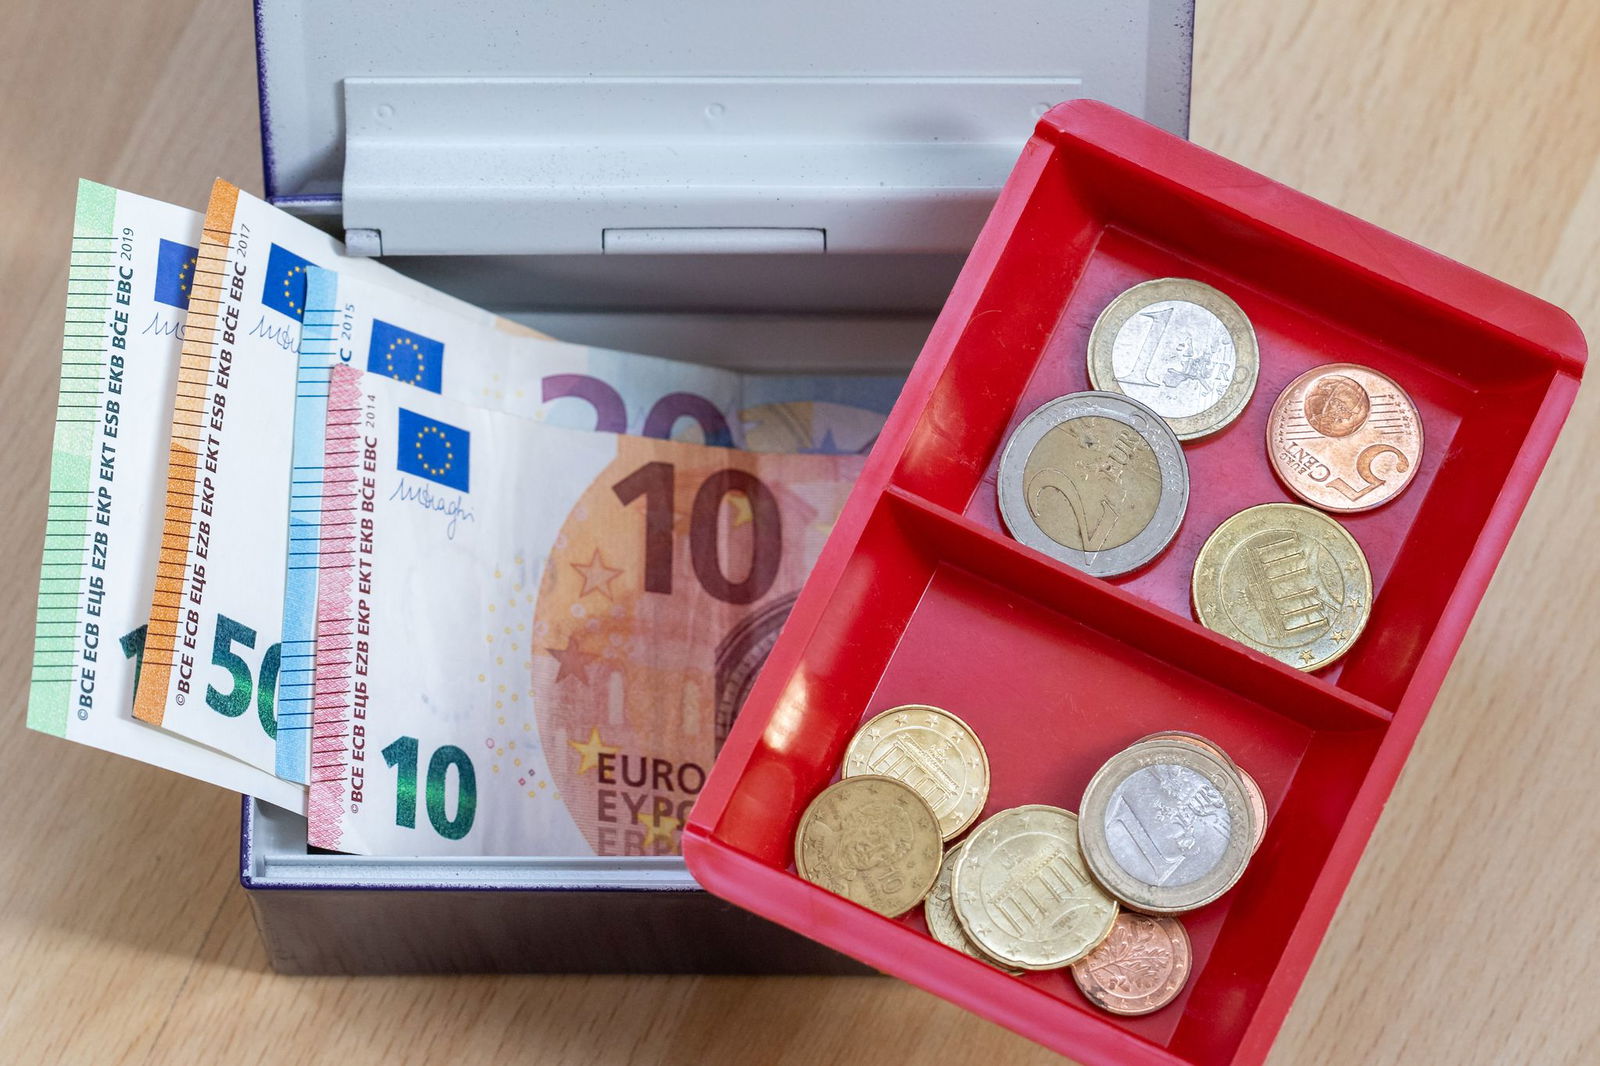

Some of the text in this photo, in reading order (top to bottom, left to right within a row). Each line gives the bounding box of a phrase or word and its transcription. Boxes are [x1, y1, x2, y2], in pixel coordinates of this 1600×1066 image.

[120, 227, 134, 261] 2019
[236, 224, 251, 258] 2017
[116, 265, 134, 306] EBC
[230, 261, 247, 302] EBC
[341, 303, 356, 341] 2015
[1111, 306, 1174, 388] 1
[108, 354, 125, 395] EKB
[216, 349, 233, 389] EKB
[104, 400, 120, 438] ESB
[210, 393, 226, 432] ESB
[366, 394, 376, 428] 2014
[364, 436, 378, 472] EBC
[1282, 441, 1331, 483] CENT
[1325, 443, 1410, 502] 5
[96, 486, 112, 526] EKP
[201, 477, 216, 517] EKP
[360, 518, 374, 555] EKB
[612, 460, 783, 606] 10
[1026, 468, 1119, 567] 2
[91, 531, 109, 570] EZB
[196, 520, 211, 560] EZB
[184, 609, 200, 649] ECB
[357, 599, 371, 636] EKP
[83, 622, 99, 663] ECB
[356, 640, 369, 676] EZB
[352, 724, 365, 761] ECB
[381, 735, 477, 840] 10
[598, 752, 706, 795] EURO
[1105, 795, 1186, 887] 1
